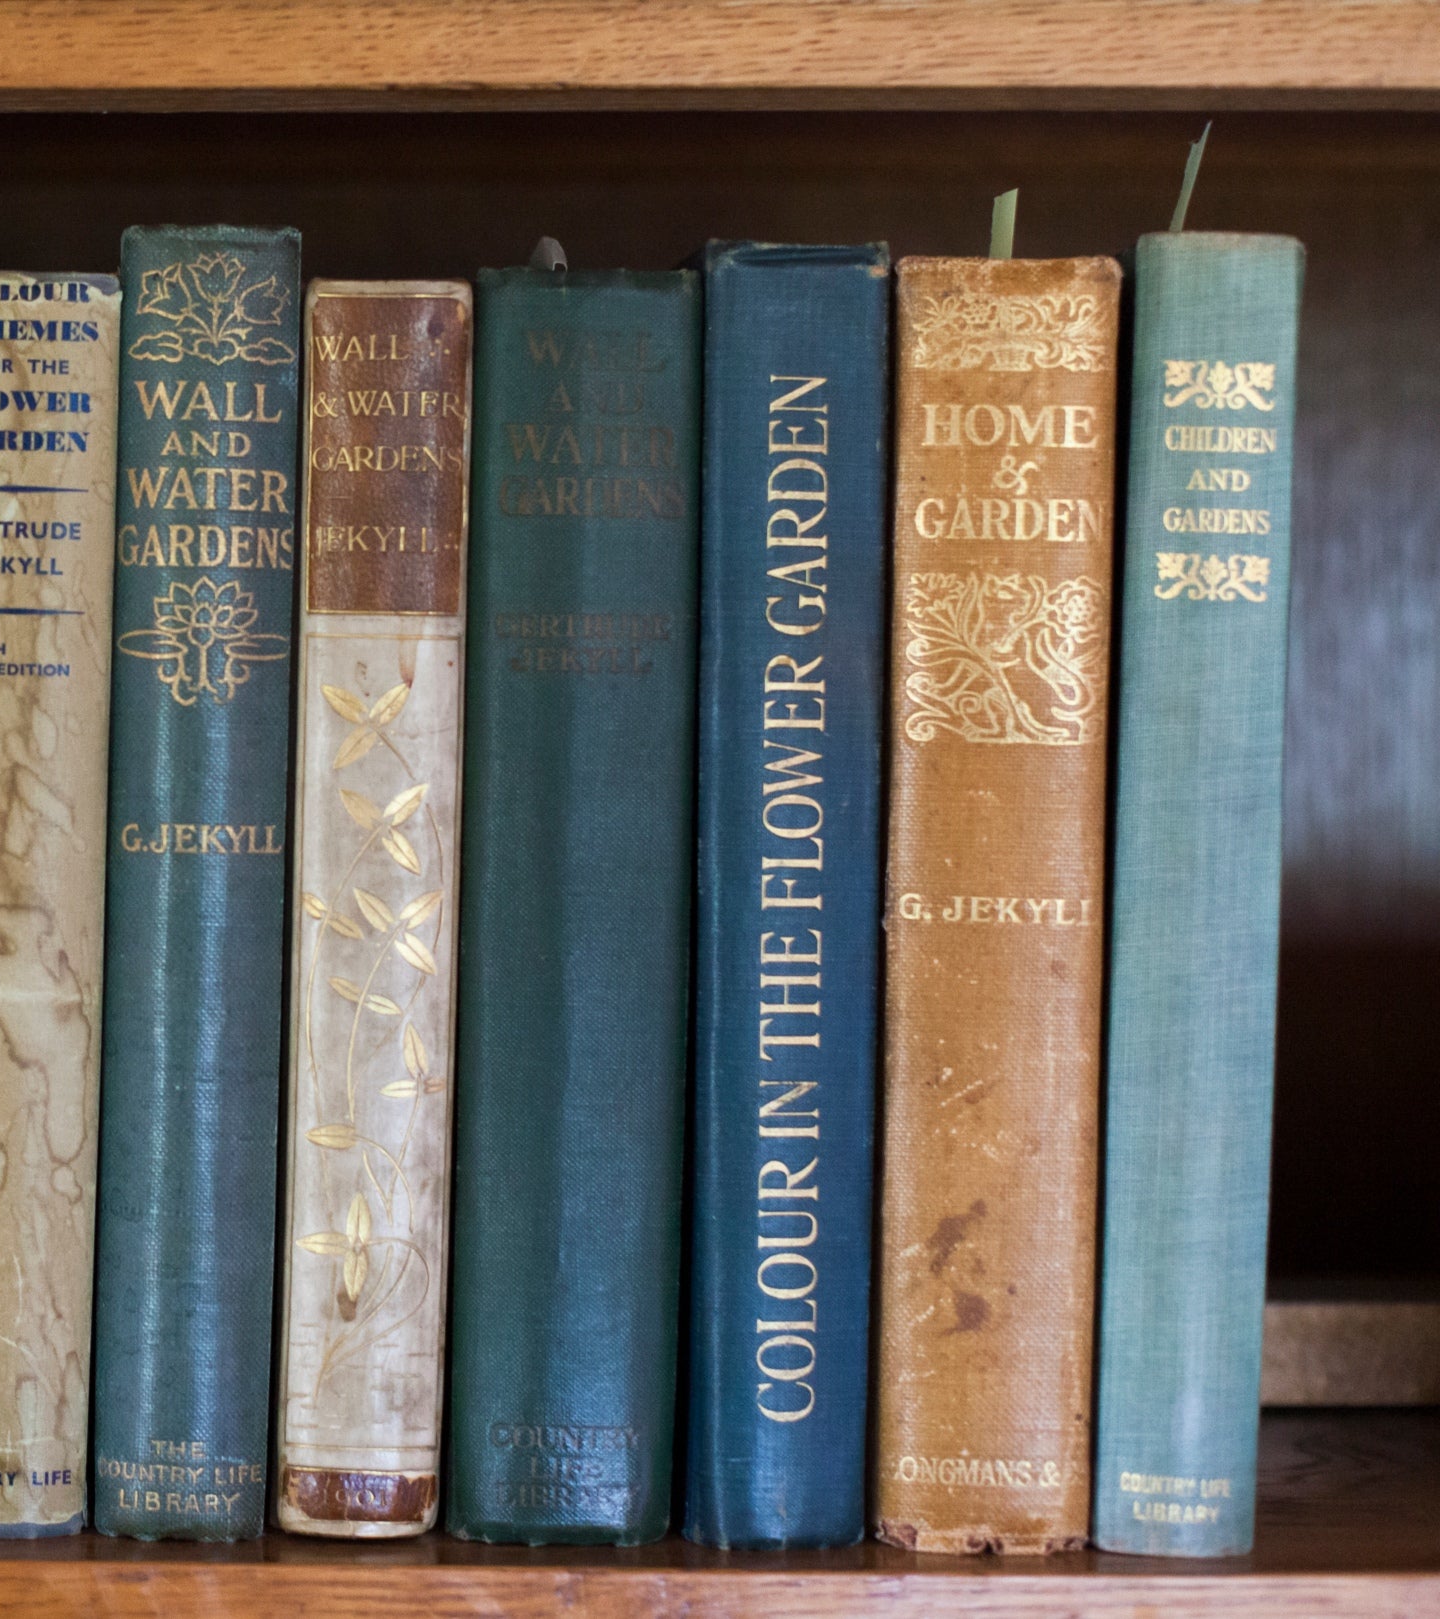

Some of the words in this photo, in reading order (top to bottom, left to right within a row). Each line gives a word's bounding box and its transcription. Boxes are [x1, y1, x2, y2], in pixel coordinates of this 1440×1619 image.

[313, 333, 410, 362] WALL
[27, 359, 70, 375] THE
[134, 380, 283, 424] WALL
[313, 391, 339, 418] &
[347, 390, 466, 419] WATER
[921, 403, 1100, 449] HOME
[1164, 425, 1278, 454] CHILDREN
[161, 430, 252, 457] AND
[312, 444, 463, 473] GARDENS
[502, 423, 680, 468] WATER
[126, 466, 290, 514] WATER
[992, 454, 1040, 496] &
[1185, 468, 1251, 493] AND
[499, 476, 685, 519] GARDENS
[764, 375, 828, 635] GARDEN
[914, 497, 1105, 543] GARDEN
[1162, 507, 1272, 535] GARDENS
[118, 524, 294, 571] GARDENS
[496, 613, 670, 640] GERTRUDE
[511, 647, 653, 673] JEKYLL
[760, 654, 826, 912] FLOWER
[898, 892, 933, 922] G.
[760, 928, 822, 1061] THE
[759, 1080, 820, 1139] IN
[756, 1157, 820, 1423] COLOUR
[151, 1439, 207, 1459] THE
[32, 1469, 72, 1486] LIFE
[97, 1456, 204, 1484] COUNTRY
[214, 1463, 263, 1486] LIFE
[893, 1455, 1033, 1487] ONGMANS
[1039, 1460, 1061, 1488] &
[1121, 1471, 1197, 1497] COUNTRY
[1200, 1478, 1231, 1498] LIFE
[119, 1488, 241, 1515] LIBRARY
[1133, 1500, 1219, 1524] LIBRARY
